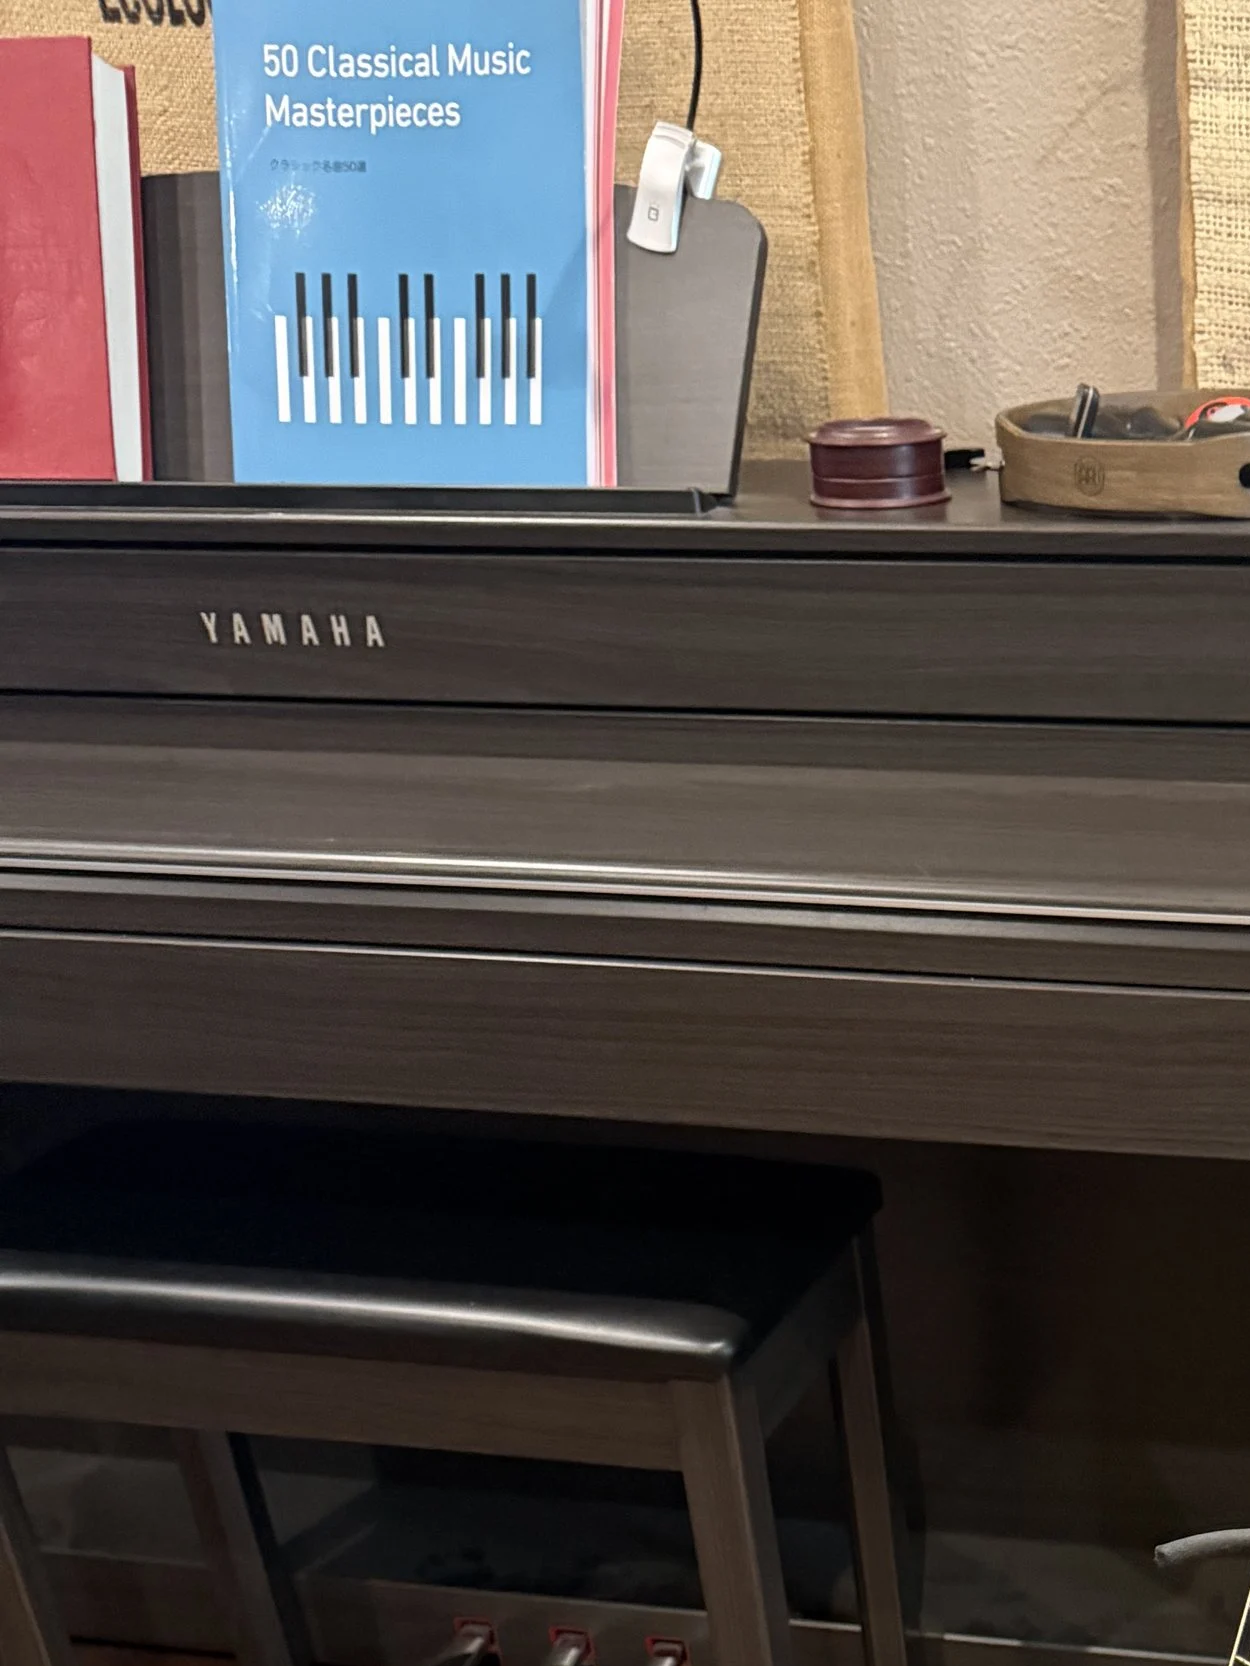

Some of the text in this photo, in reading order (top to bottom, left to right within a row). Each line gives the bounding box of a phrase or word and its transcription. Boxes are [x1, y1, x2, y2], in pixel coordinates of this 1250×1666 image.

[263, 41, 531, 78] 50 Classical Music
[265, 93, 461, 135] Masterpieces
[200, 611, 386, 648] YAMAHA
